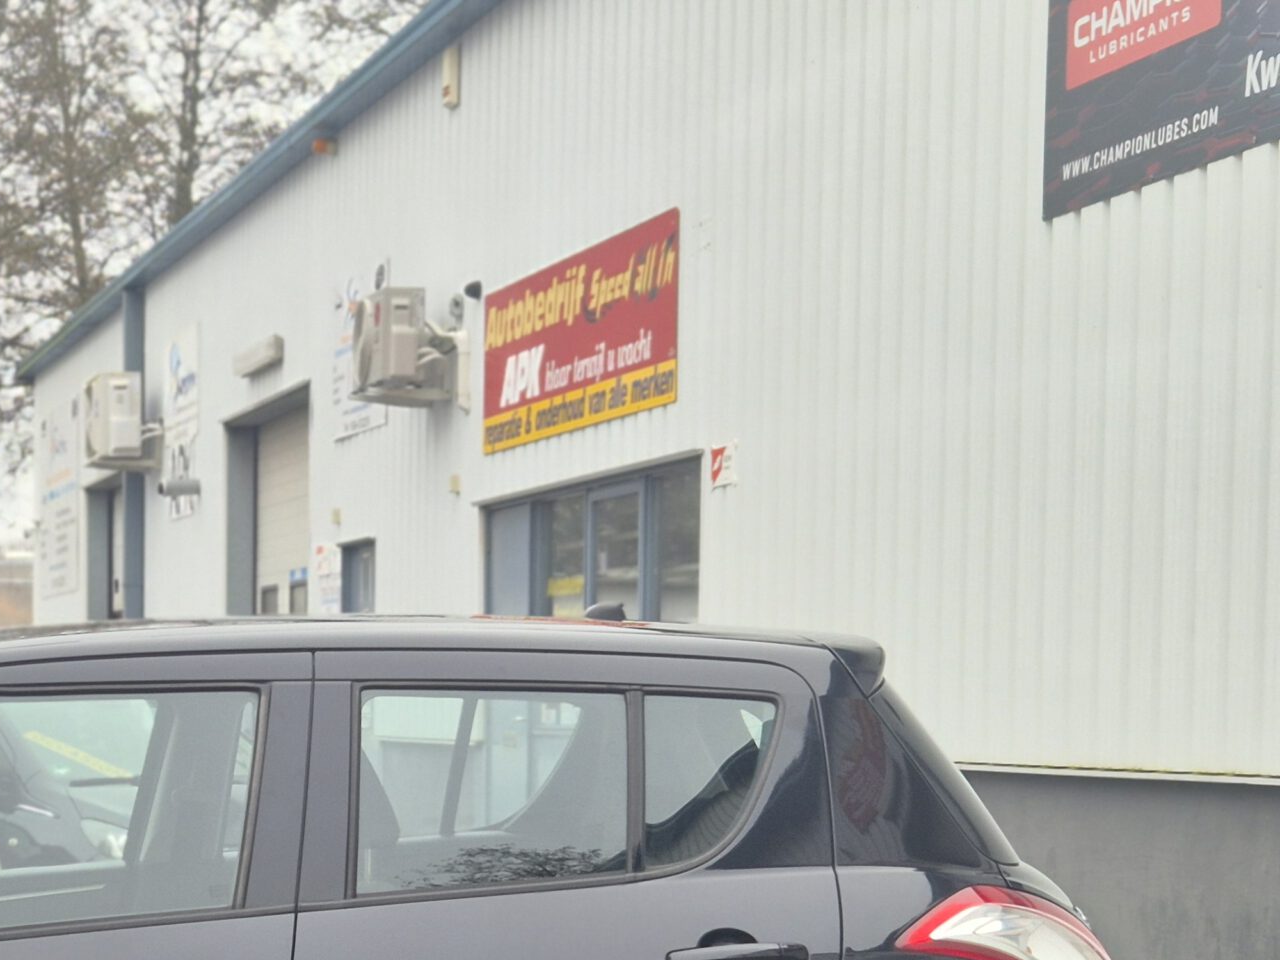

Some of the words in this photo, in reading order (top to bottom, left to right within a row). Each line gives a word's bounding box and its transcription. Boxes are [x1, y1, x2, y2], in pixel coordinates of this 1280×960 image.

[1088, 6, 1192, 63] LUBRICANTS
[1062, 106, 1219, 181] WWW.CHAMPIONLUBES.COM
[485, 263, 587, 351] Autobedrijf
[588, 253, 635, 320] Speed
[634, 243, 658, 296] all
[499, 343, 546, 408] APK
[544, 360, 572, 392] klaar
[573, 341, 606, 383] terwijl
[607, 349, 615, 371] u
[617, 328, 652, 368] wacht
[535, 390, 585, 431] onderhoud
[588, 389, 606, 415] van
[608, 377, 627, 409] alle
[631, 366, 675, 403] merken
